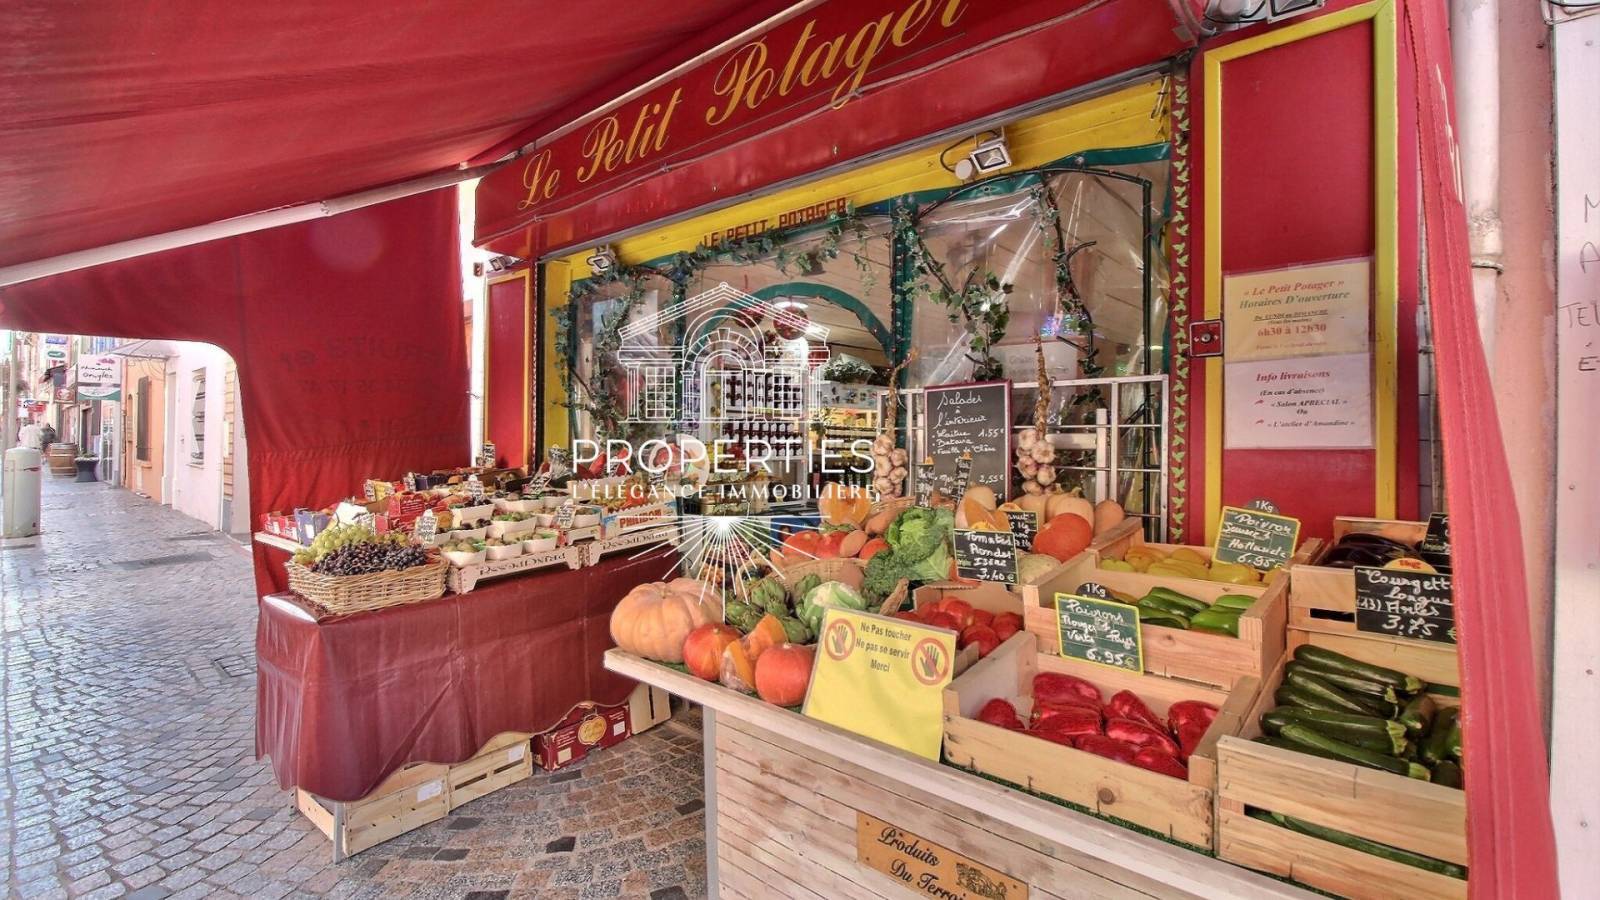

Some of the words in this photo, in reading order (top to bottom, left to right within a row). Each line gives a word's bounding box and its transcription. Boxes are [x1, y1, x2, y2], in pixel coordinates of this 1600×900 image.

[518, 149, 560, 210] Le
[577, 87, 683, 183] Petit
[705, 0, 969, 126] Potager
[726, 219, 769, 241] PETIT
[779, 197, 846, 229] POTAGER
[1252, 287, 1266, 296] Le
[1268, 285, 1291, 294] Petit
[1294, 280, 1335, 292] Potager
[1240, 299, 1282, 309] Horaires
[1285, 291, 1350, 305] D'ouverture
[1257, 327, 1282, 337] 6h30
[1285, 326, 1291, 335] à
[1295, 323, 1327, 334] 12h30
[1256, 373, 1278, 383] Info
[1280, 370, 1330, 381] livraisons
[937, 391, 982, 410] Salades
[1276, 400, 1297, 408] Salon
[1255, 500, 1274, 513] 1Kg
[1086, 583, 1106, 597] 1Kg
[1367, 571, 1453, 594] Courgett
[860, 621, 870, 633] Ne
[871, 624, 884, 636] Pas
[885, 627, 912, 641] toucher
[856, 638, 865, 649] Ne
[866, 641, 878, 653] pas
[880, 645, 888, 654] se
[889, 646, 910, 659] servir
[870, 659, 890, 673] Merci
[877, 826, 940, 867] Produits
[890, 858, 913, 883] Du
